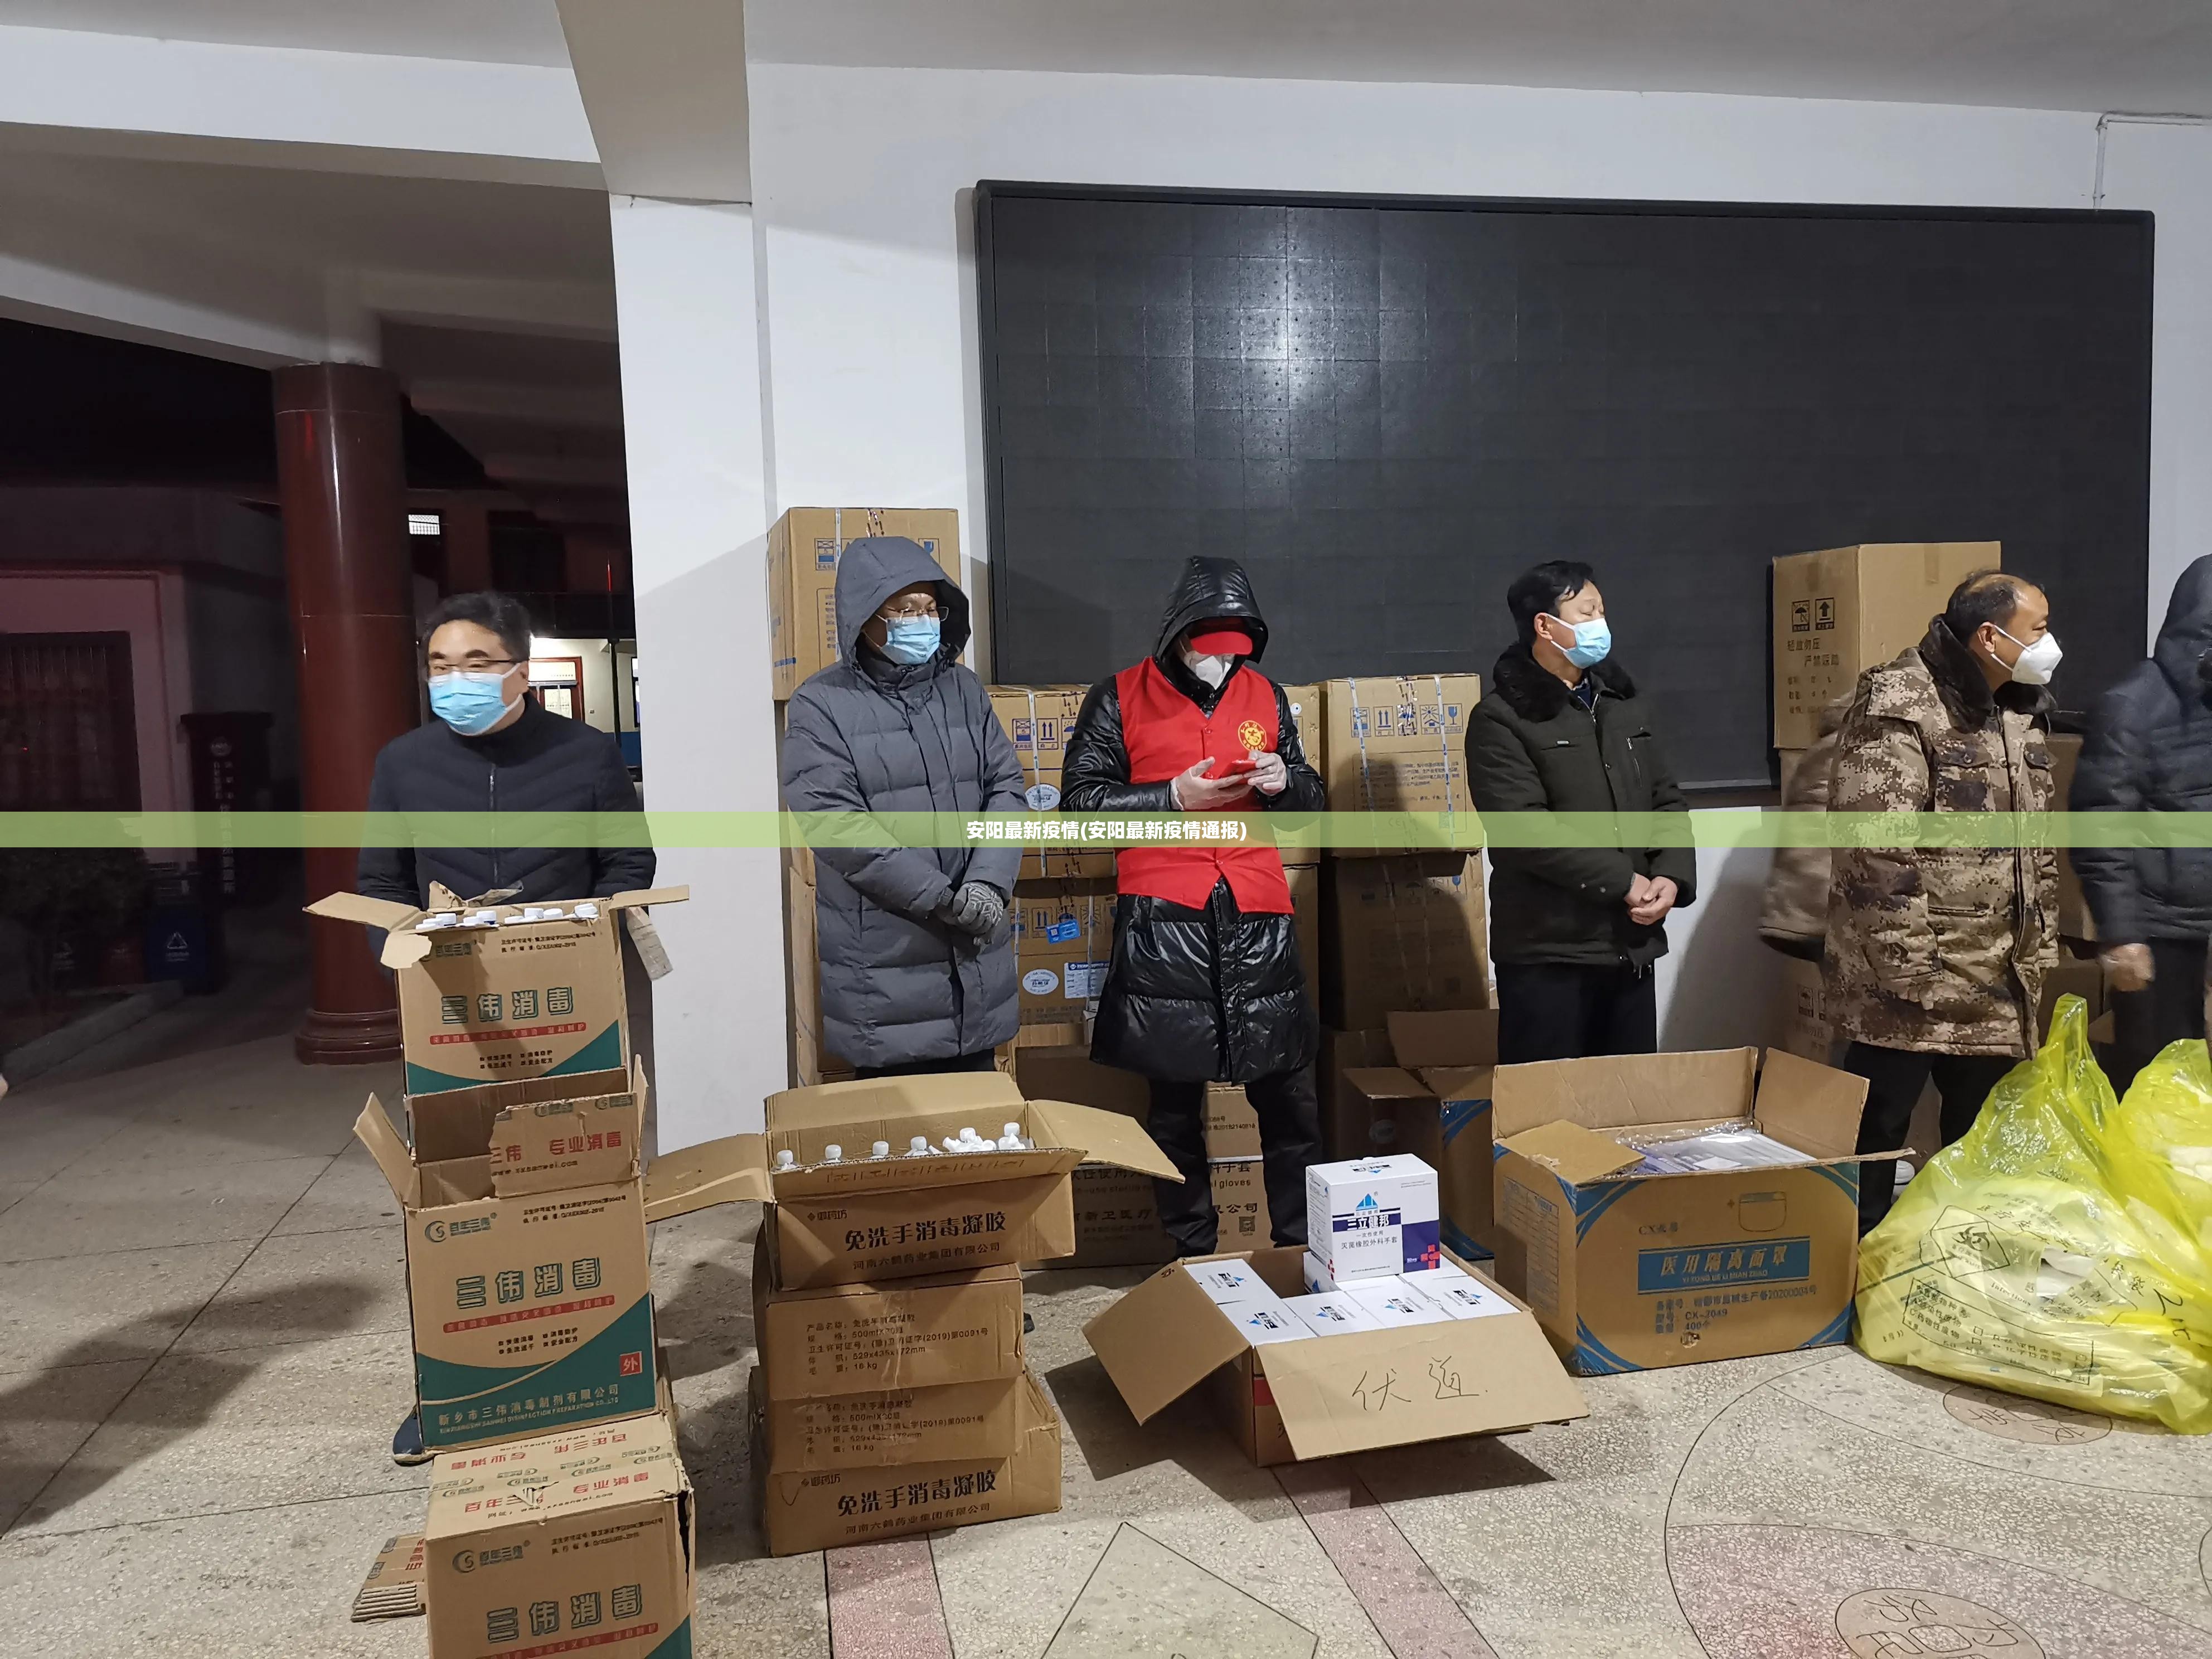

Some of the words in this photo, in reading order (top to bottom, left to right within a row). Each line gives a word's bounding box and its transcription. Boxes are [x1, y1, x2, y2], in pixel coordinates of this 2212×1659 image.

[442, 986, 574, 1024] 三伟消毒
[549, 1131, 622, 1156] 专业消毒
[1219, 1179, 1251, 1189] gloves
[845, 1211, 1007, 1251] 免洗手消毒凝胶
[1347, 1214, 1389, 1231] 三立健邦
[1341, 1236, 1398, 1249] 灭菌橡胶外科手套
[1660, 1244, 1787, 1277] 医用隔离面罩
[456, 1257, 601, 1309] 三伟消毒
[624, 1358, 638, 1372] 外
[439, 1384, 618, 1426] 新乡市三伟消毒制剂有限公司
[838, 1469, 996, 1517] 免洗手消毒凝胶
[487, 1584, 642, 1643] 三伟消毒
